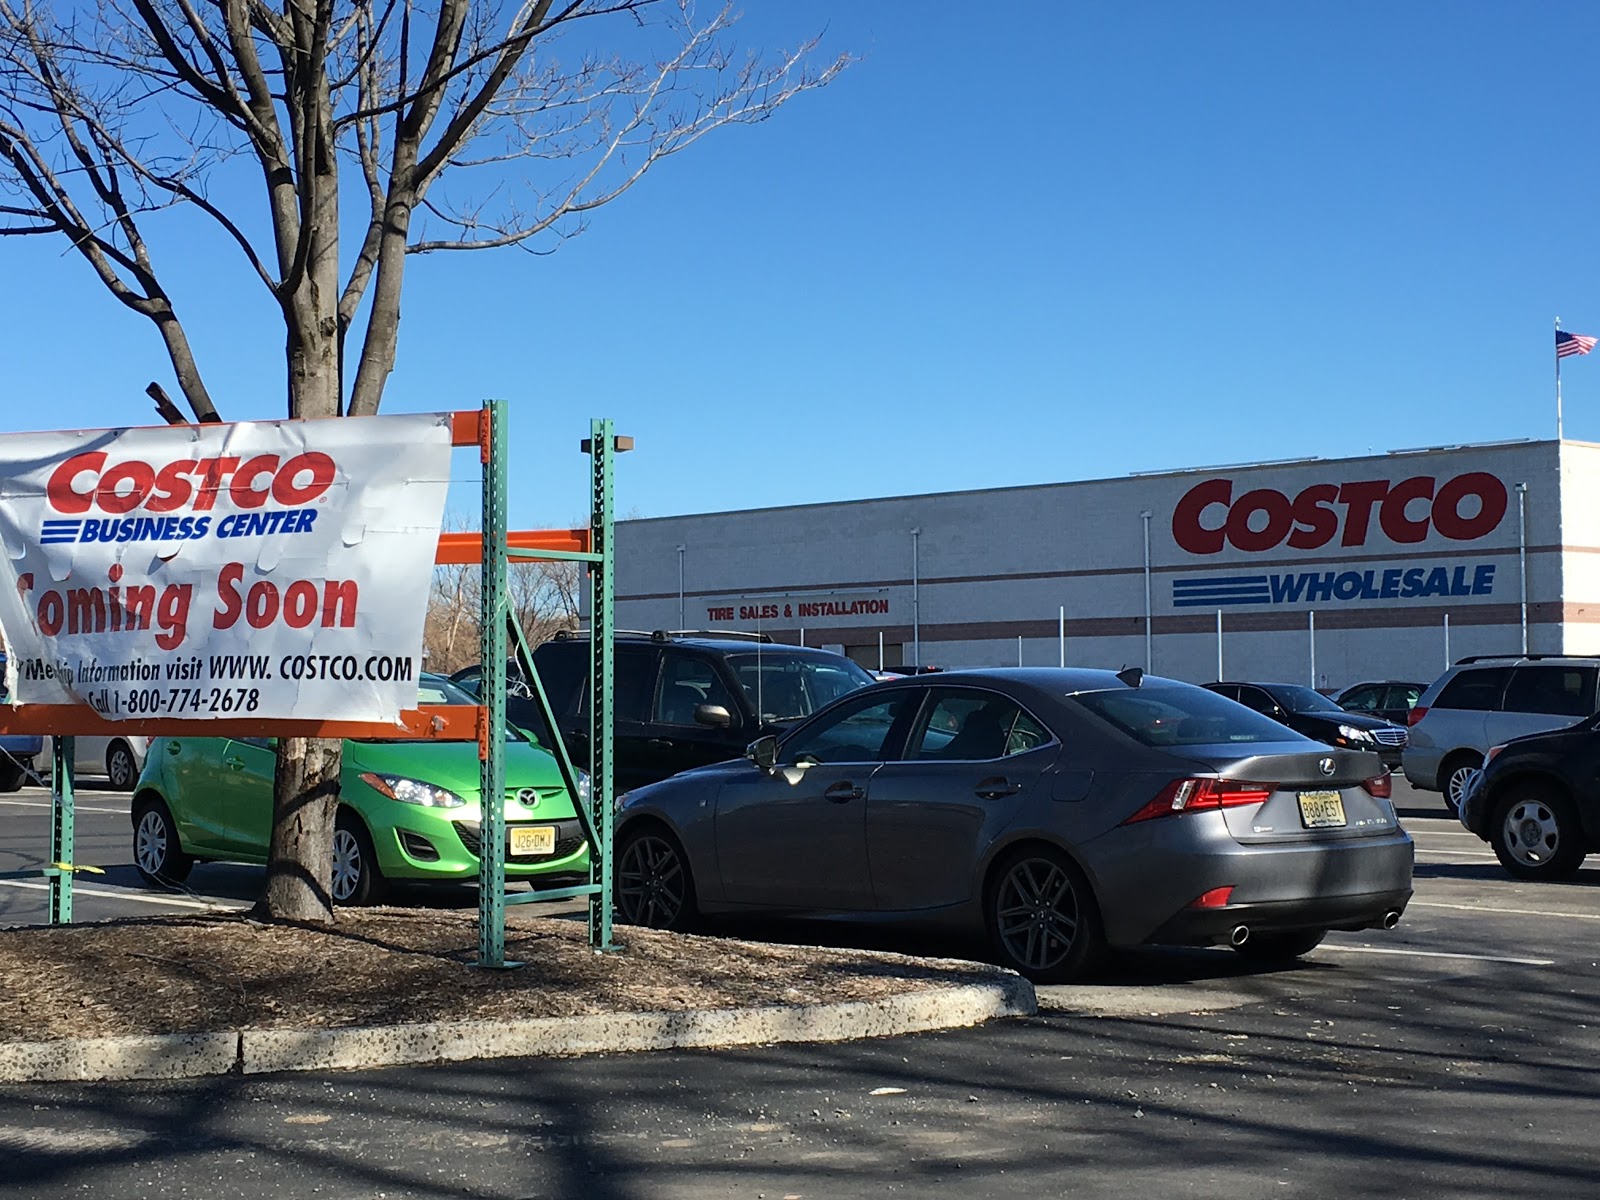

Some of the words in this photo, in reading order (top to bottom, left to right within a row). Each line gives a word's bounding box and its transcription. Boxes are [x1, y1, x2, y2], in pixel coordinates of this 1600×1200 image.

[46, 451, 336, 513] COSTCO
[79, 516, 212, 543] BUSINESS
[216, 508, 318, 539] CENTER
[1172, 472, 1508, 554] COSTCO
[212, 561, 358, 629] Soon
[1268, 564, 1496, 603] WHOLESALE
[707, 607, 734, 621] TIRE
[739, 605, 778, 620] SALES
[783, 604, 792, 618] &
[799, 600, 888, 617] INSTALLATION
[78, 657, 160, 684] Information
[166, 656, 203, 680] visit
[209, 655, 272, 680] WWW.
[280, 655, 412, 681] COSTCO.COM
[114, 688, 260, 714] 1-800-774-2678
